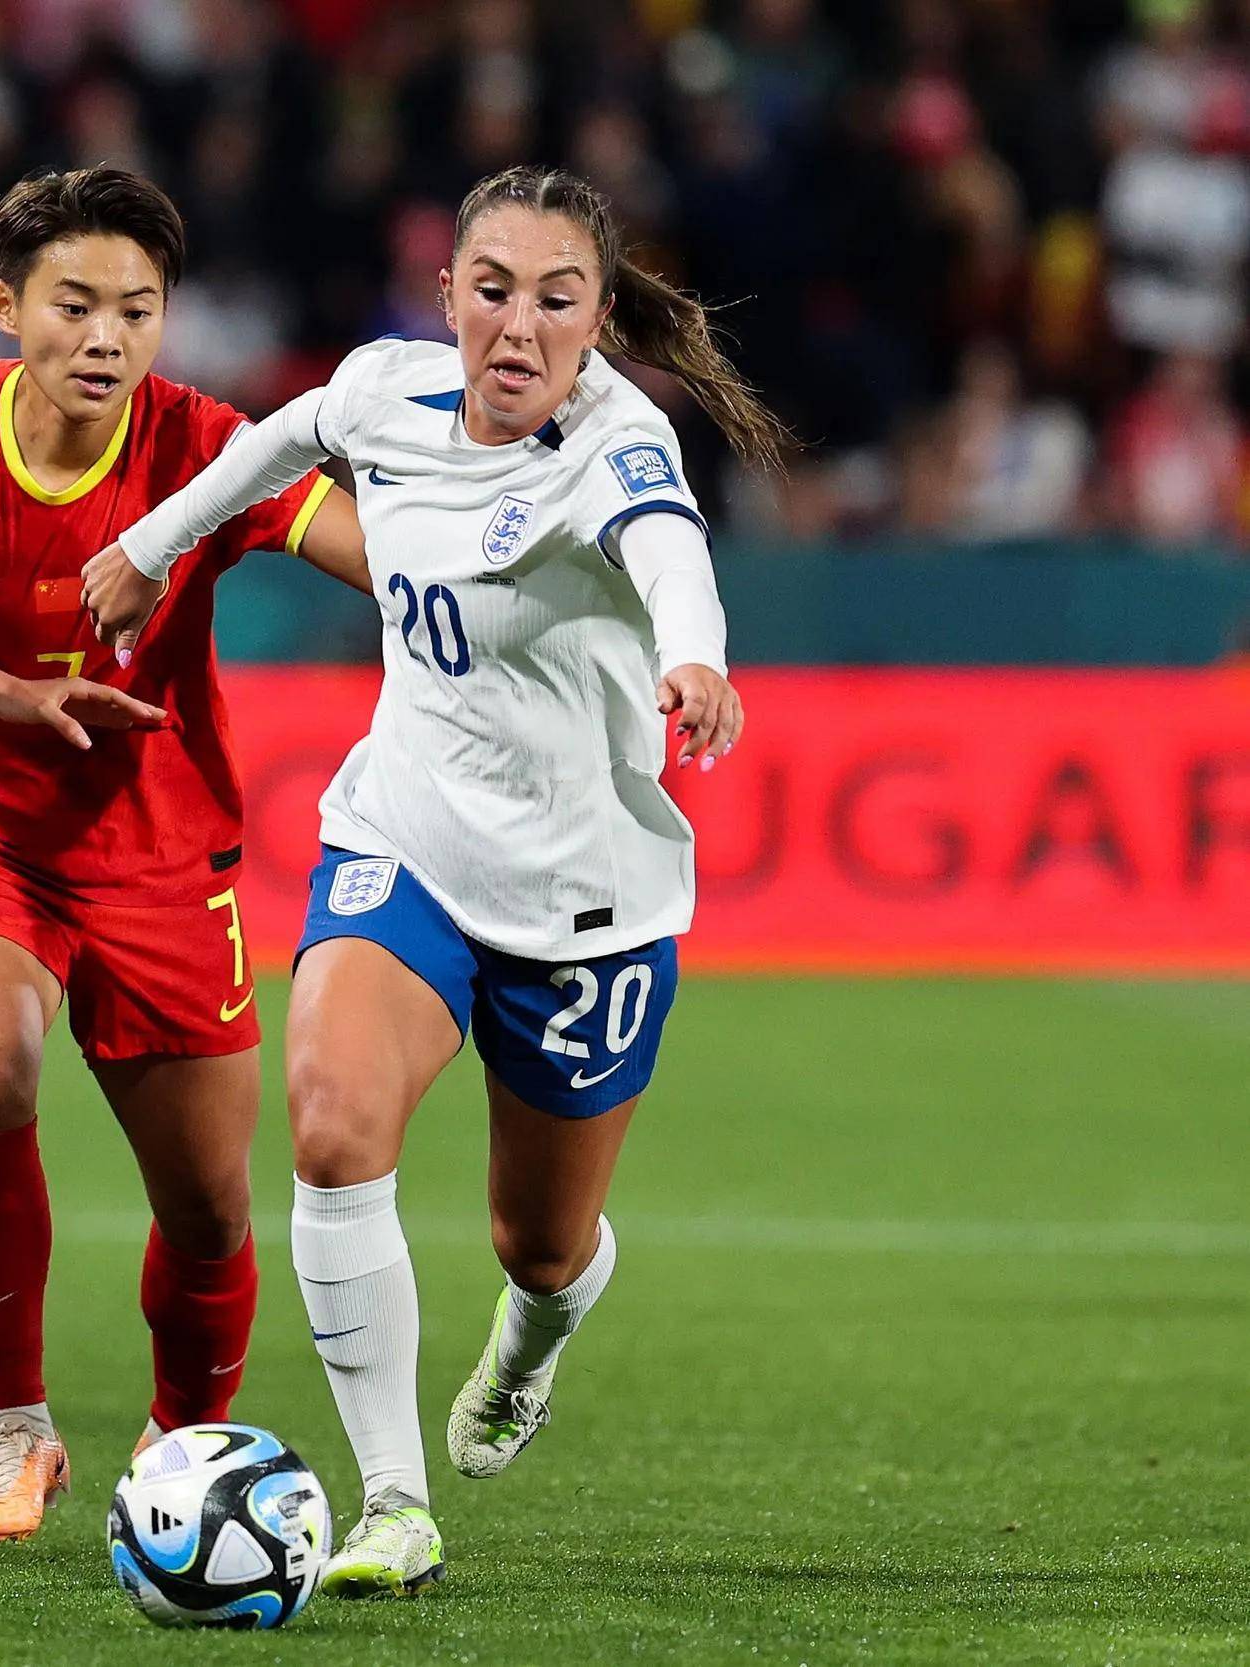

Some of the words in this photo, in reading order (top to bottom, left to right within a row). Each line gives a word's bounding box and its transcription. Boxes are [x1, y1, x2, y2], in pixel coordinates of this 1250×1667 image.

[388, 572, 470, 677] 20
[206, 886, 244, 986] 7
[541, 963, 653, 1059] 20
